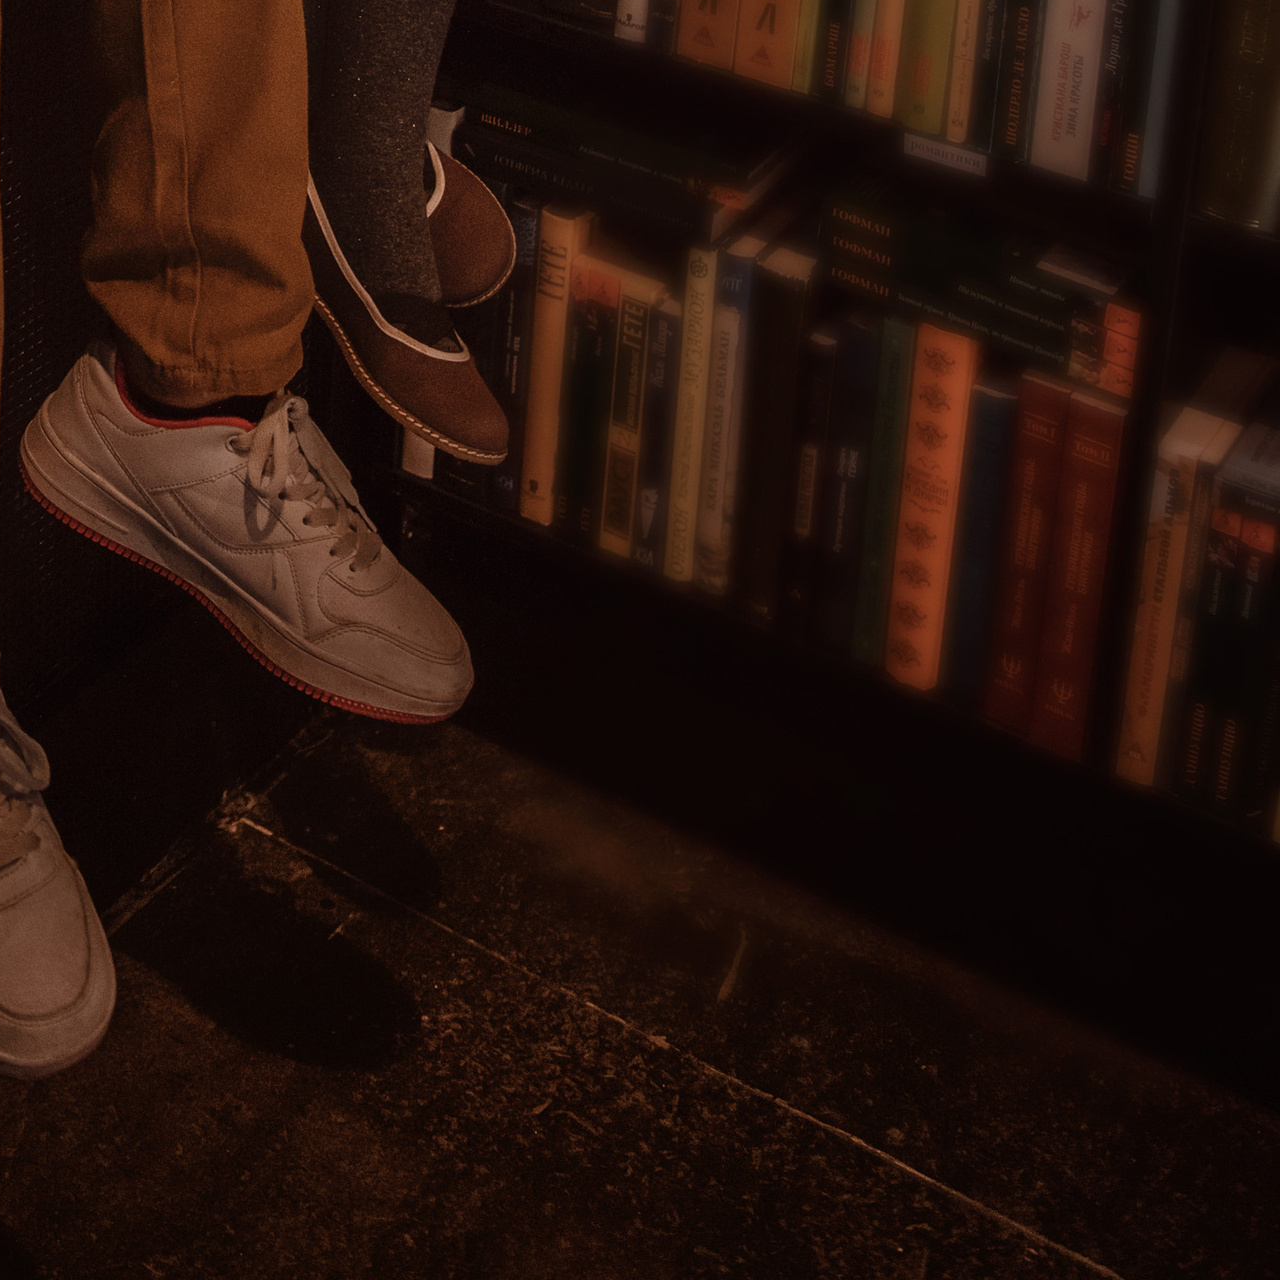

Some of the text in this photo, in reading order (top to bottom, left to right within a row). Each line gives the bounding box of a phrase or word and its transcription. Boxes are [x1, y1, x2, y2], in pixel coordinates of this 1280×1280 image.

[823, 21, 841, 88] БОМАРШЕ
[1004, 6, 1030, 146] ШОДЕРЛО ДЕ ЛАКЛО
[1104, 35, 1123, 75] Лоран
[1050, 42, 1072, 143] КРИСТИАНА БАРОШ
[1065, 54, 1085, 138] ЗИМА КРАСОТЫ
[911, 141, 981, 169] романтики
[831, 207, 892, 238] ГОФМАН
[536, 240, 568, 303] ГЕТЕ
[832, 235, 892, 267] ГОФМАН
[830, 266, 890, 297] ГОФМАН
[623, 301, 645, 351] ГЕТЕ
[1151, 530, 1172, 603] СТАЛЬНОЙ
